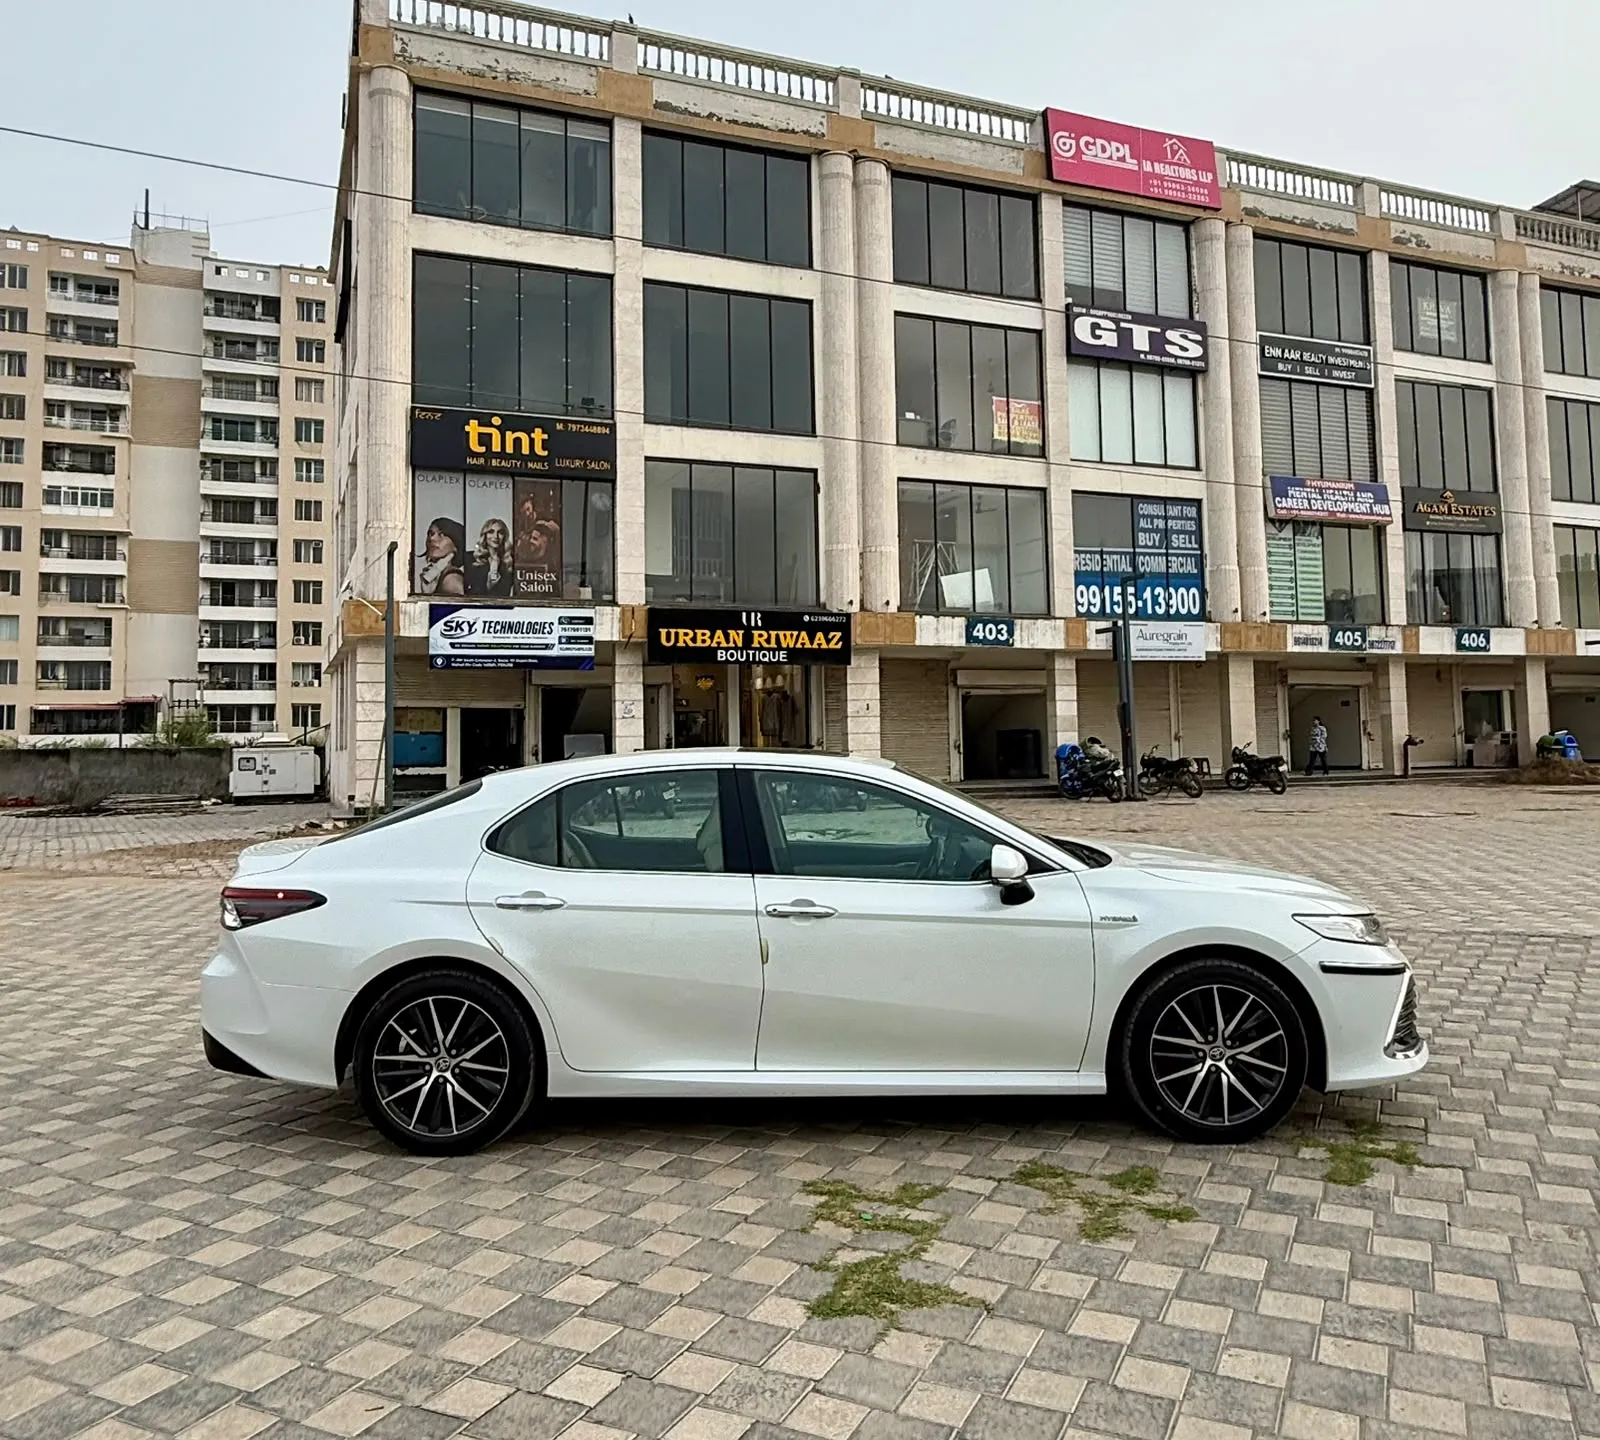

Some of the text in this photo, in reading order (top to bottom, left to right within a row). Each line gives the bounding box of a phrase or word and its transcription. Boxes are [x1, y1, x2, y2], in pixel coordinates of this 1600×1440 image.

[1080, 136, 1138, 164] GDPL
[1154, 163, 1198, 181] REALTORS
[1198, 170, 1214, 183] LLP
[1074, 316, 1204, 359] GTS
[1264, 345, 1282, 358] ENN
[1284, 348, 1301, 361] AAR
[1302, 351, 1327, 364] REALTY
[1278, 363, 1356, 379] BUY SELL INVEST
[465, 416, 549, 456] tint
[466, 456, 611, 470] HAIR BEAUTY NAILS LUXURY SALON
[417, 473, 461, 485] OLAPLEX
[467, 478, 511, 490] OLAPLEX
[1182, 506, 1197, 518] FOR
[1275, 497, 1312, 510] CAREER
[1311, 498, 1370, 513] DEVELOPMENT
[1371, 503, 1390, 515] HUB
[1416, 501, 1448, 514] AGAM
[1451, 503, 1497, 517] ESTATES
[1139, 518, 1153, 528] ALL
[1138, 532, 1199, 548] BUY SELL
[1073, 553, 1133, 572] RESIDENTIAL
[516, 570, 557, 581] Unisex
[520, 581, 554, 593] Salon
[1076, 585, 1200, 615] 99155-13900
[443, 620, 555, 635] SKY TECHNOLOGIES
[973, 623, 1008, 641] 403
[658, 628, 843, 649] URBAN RIWAAZ
[1136, 628, 1188, 645] Auregrain
[1334, 630, 1362, 646] 405
[1460, 632, 1486, 648] 406
[717, 650, 789, 662] BOUTIQUE
